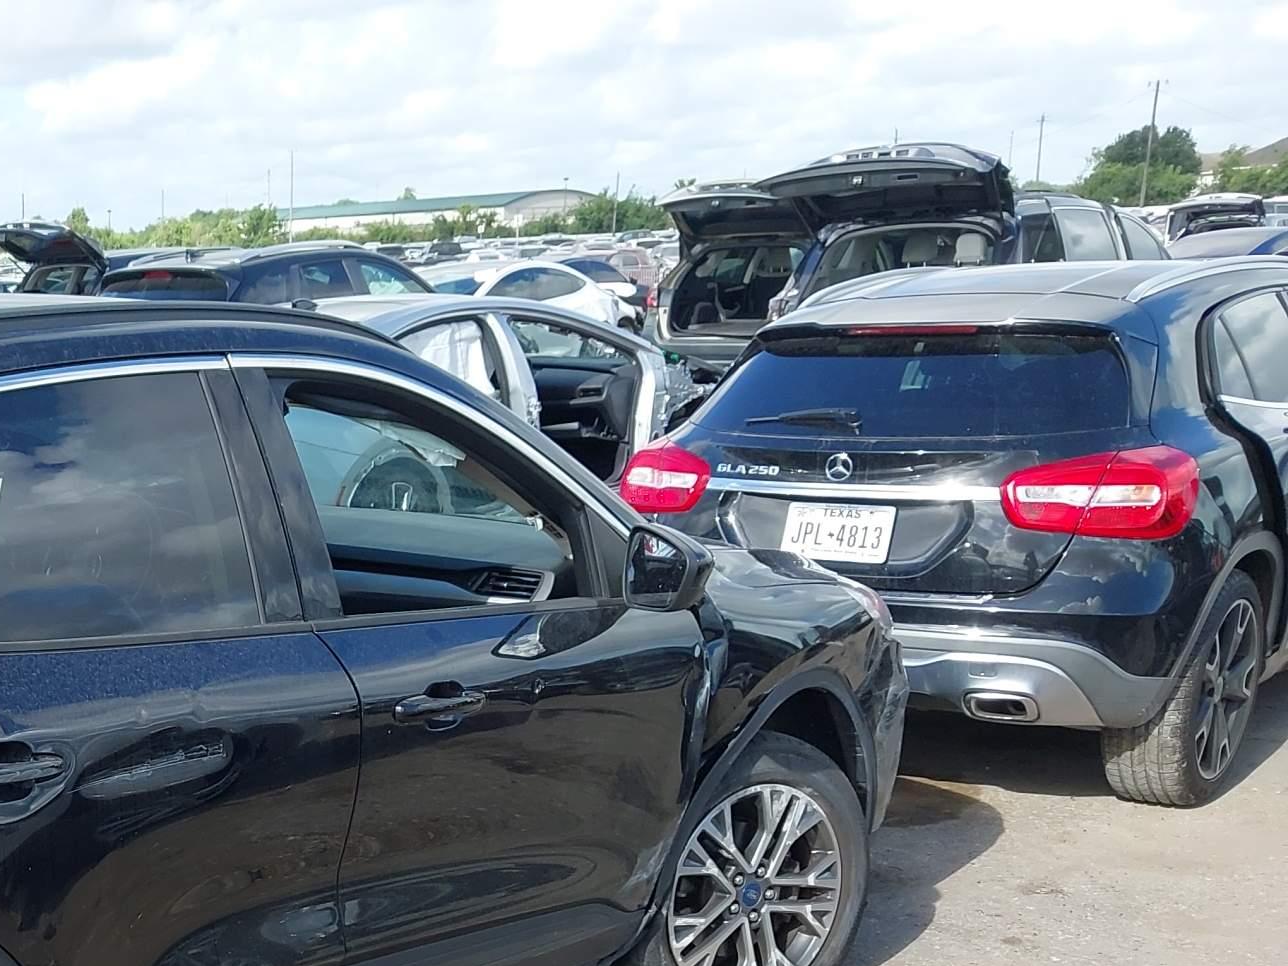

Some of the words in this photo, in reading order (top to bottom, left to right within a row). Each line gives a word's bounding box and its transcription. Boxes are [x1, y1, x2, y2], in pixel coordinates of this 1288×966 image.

[717, 463, 746, 474] GLA
[748, 465, 780, 476] 250
[823, 508, 861, 519] TEXAS
